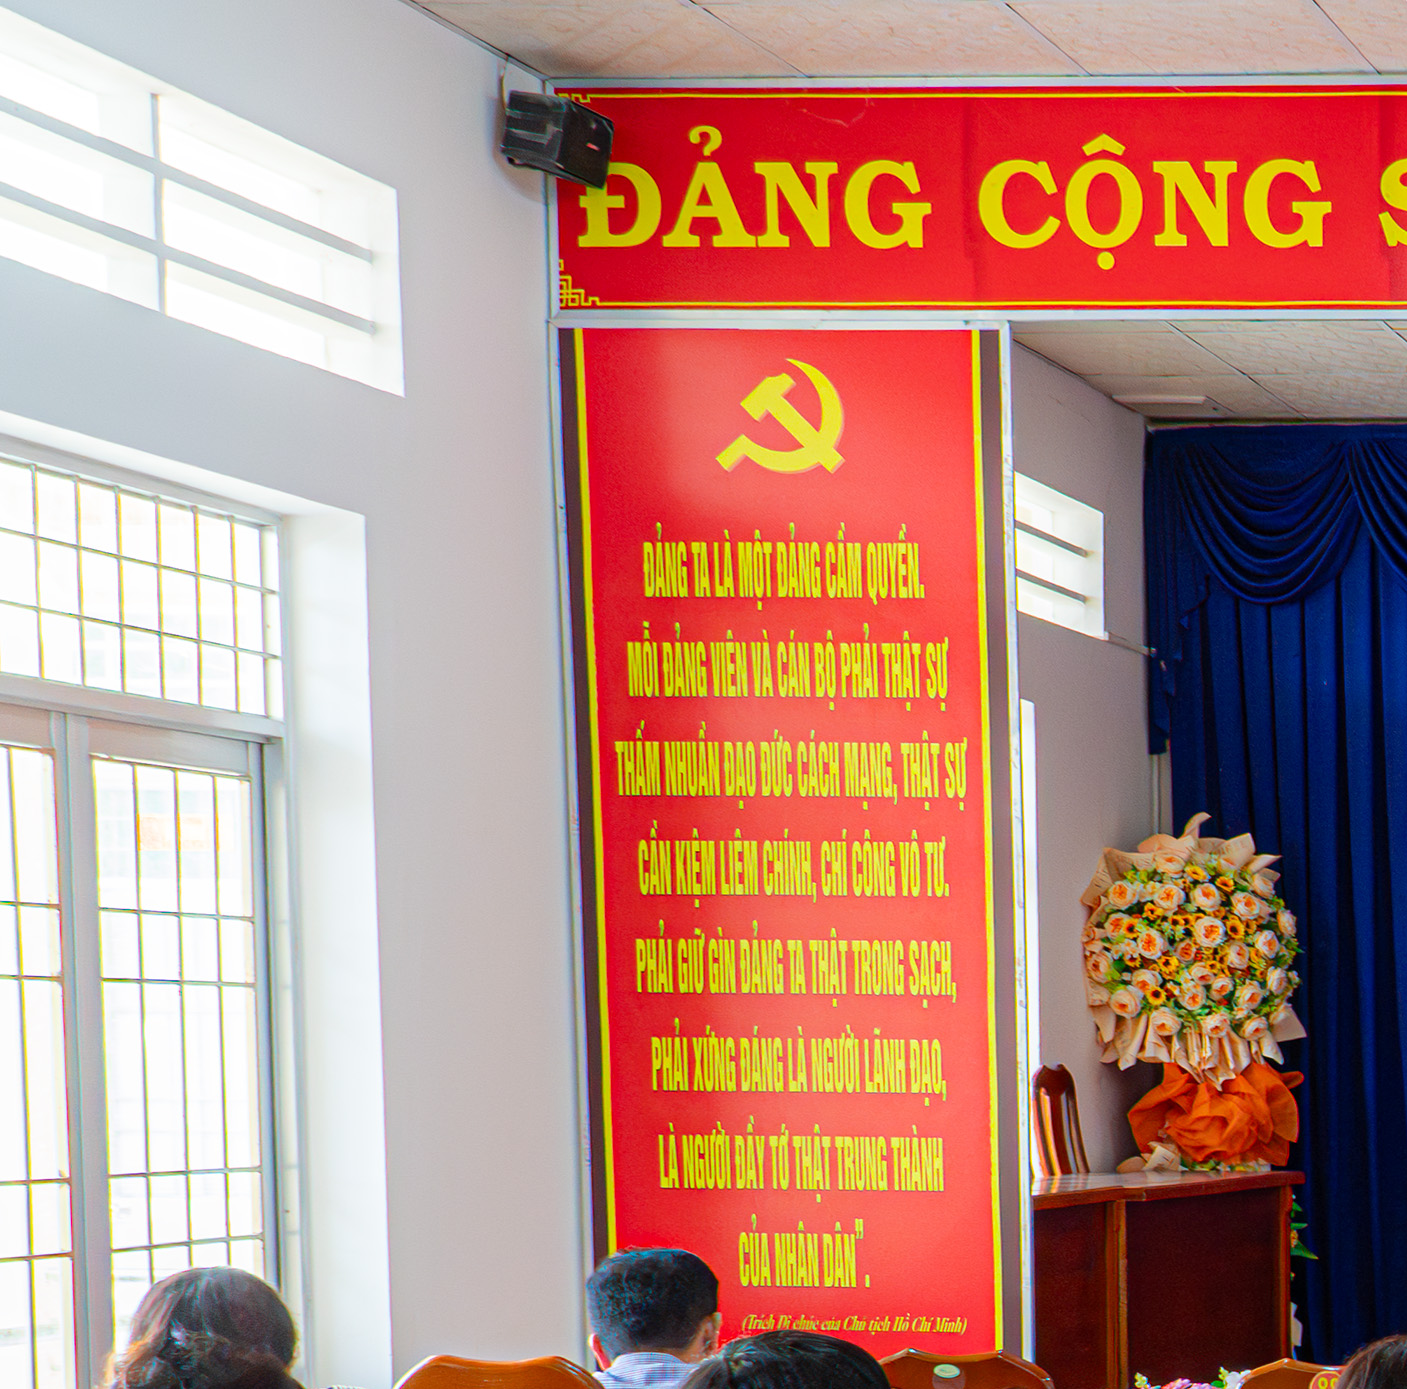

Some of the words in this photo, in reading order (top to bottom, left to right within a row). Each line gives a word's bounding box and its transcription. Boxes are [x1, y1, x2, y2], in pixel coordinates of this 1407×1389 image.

[578, 126, 931, 249] ĐẢNG
[979, 134, 1331, 270] CỘNG
[644, 522, 688, 597] ĐẢNG
[691, 542, 711, 597] TA
[714, 529, 734, 597] LÀ
[738, 529, 772, 610] MỘT
[777, 522, 821, 598] ĐẢNG
[825, 522, 862, 598] CẦM
[867, 524, 925, 605] QUYỀN.
[627, 621, 659, 697] MỖI
[663, 622, 707, 697] ĐẢNG
[710, 630, 748, 697] VIÊN
[751, 629, 774, 697] VÀ
[777, 630, 811, 697] CÁN
[814, 630, 836, 711] BỘ
[840, 623, 879, 698] PHẢI
[881, 631, 921, 711] THẬT
[926, 637, 948, 711] SỰ
[615, 720, 660, 795] THẤM
[664, 721, 720, 796] NHUẦN
[724, 741, 756, 809] ĐẠO
[760, 729, 793, 797] ĐỨC
[797, 730, 840, 797] CÁCH
[844, 742, 897, 810] MẠNG,
[900, 730, 940, 811] THẬT
[944, 737, 968, 811] SỰ
[639, 820, 671, 895] CẦN
[675, 828, 716, 907] KIỆM
[720, 828, 758, 895] LIÊM
[763, 828, 816, 903] CHÍNH,
[821, 829, 848, 896] CHÍ
[852, 830, 896, 897] CÔNG
[899, 830, 920, 897] VÔ
[924, 836, 949, 897] TƯ.
[636, 920, 673, 993] PHẢI
[678, 928, 705, 993] GIỮ
[708, 927, 736, 993] GÌN
[740, 920, 784, 994] ĐẢNG
[787, 940, 807, 994] TA
[809, 928, 848, 1007] THẬT
[851, 940, 905, 996] TRONG
[908, 940, 957, 1008] SẠCH,
[651, 1018, 688, 1091] PHẢI
[692, 1025, 736, 1092] XỨNG
[740, 1026, 784, 1093] ĐÁNG
[787, 1026, 808, 1092] LÀ
[811, 1024, 860, 1093] NGƯỜI
[863, 1028, 906, 1093] LÃNH
[909, 1039, 946, 1106] ĐẠO,
[659, 1123, 679, 1188] LÀ
[682, 1121, 731, 1189] NGƯỜI
[735, 1115, 765, 1189] ĐẦY
[769, 1123, 789, 1190] TỚ
[792, 1123, 831, 1203] THẬT
[834, 1136, 888, 1191] TRUNG
[890, 1125, 944, 1191] THÀNH
[739, 1214, 771, 1286] CỦA
[774, 1221, 819, 1287] NHÂN
[893, 1313, 910, 1332] Hồ
[912, 1316, 934, 1332] Chí
